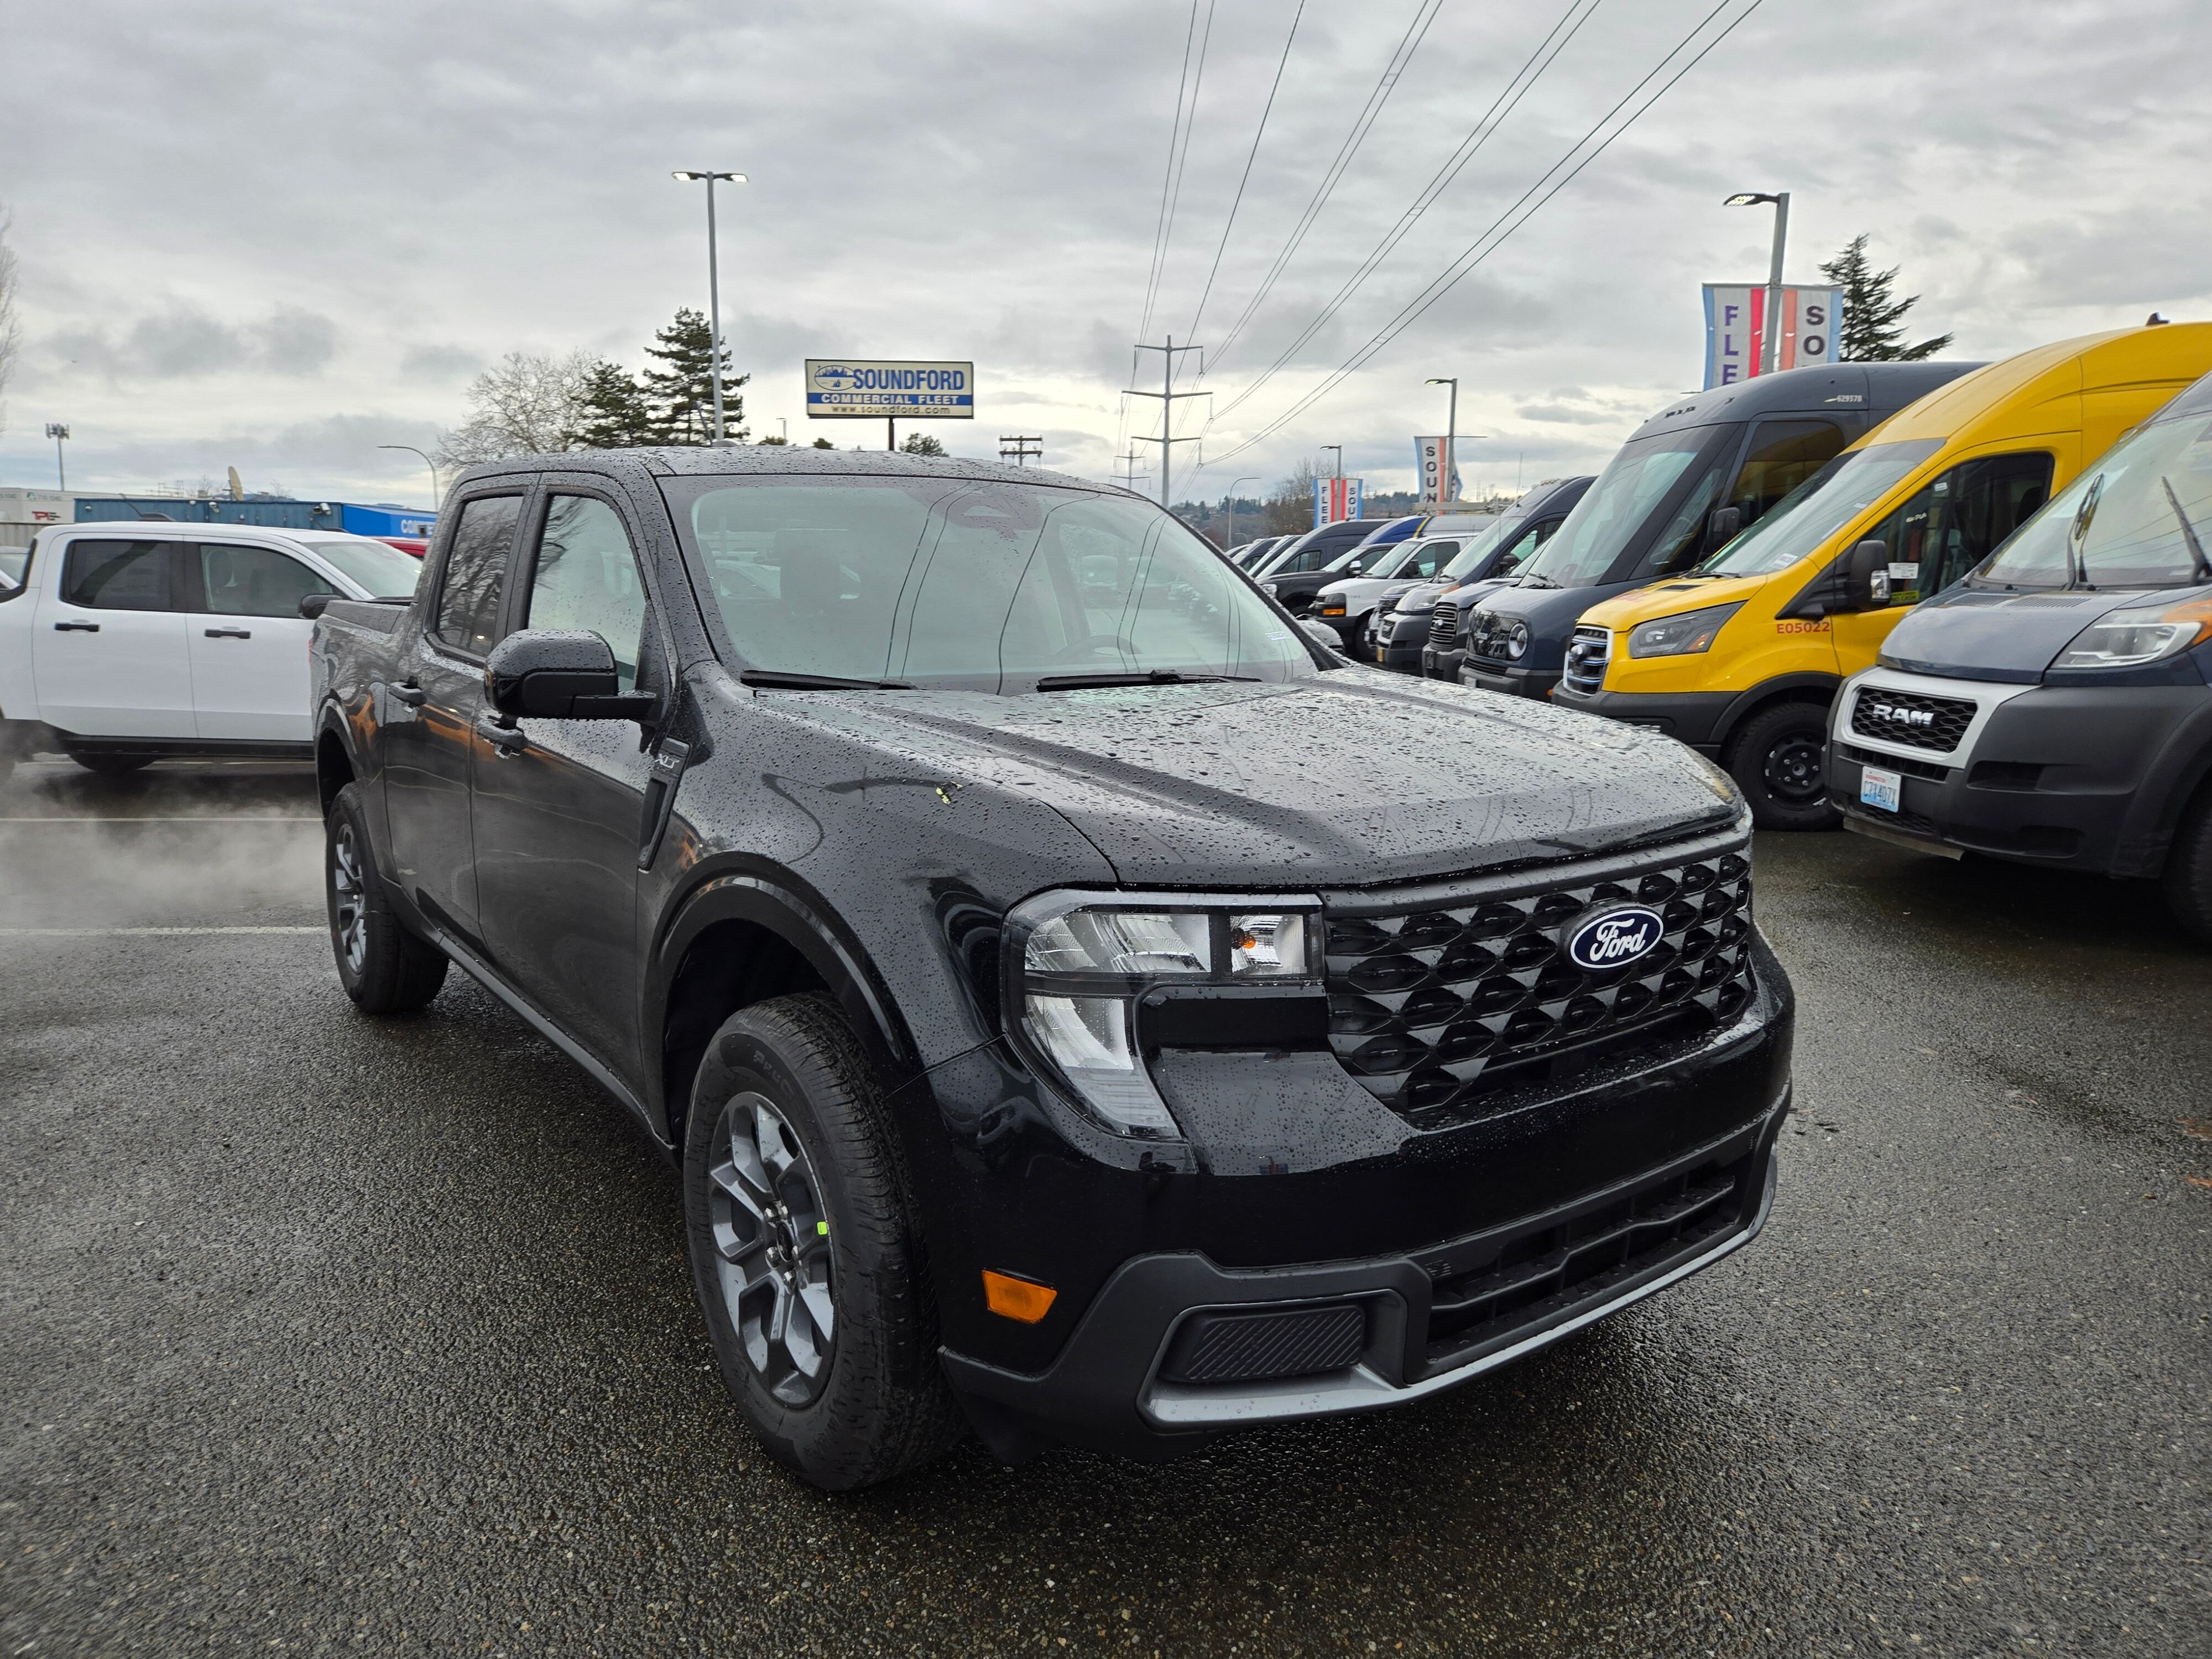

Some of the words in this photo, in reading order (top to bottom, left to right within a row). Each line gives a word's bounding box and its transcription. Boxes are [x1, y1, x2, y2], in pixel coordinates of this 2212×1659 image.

[853, 368, 964, 390] SOUNDFORD
[821, 393, 912, 404] COMMERCIAL
[918, 395, 959, 405] FLEET
[831, 405, 951, 414] www.soundford.com
[1776, 622, 1830, 634] E05022
[1872, 704, 1934, 727] RAM
[654, 753, 681, 769] XLT
[1589, 918, 1649, 962] Ford
